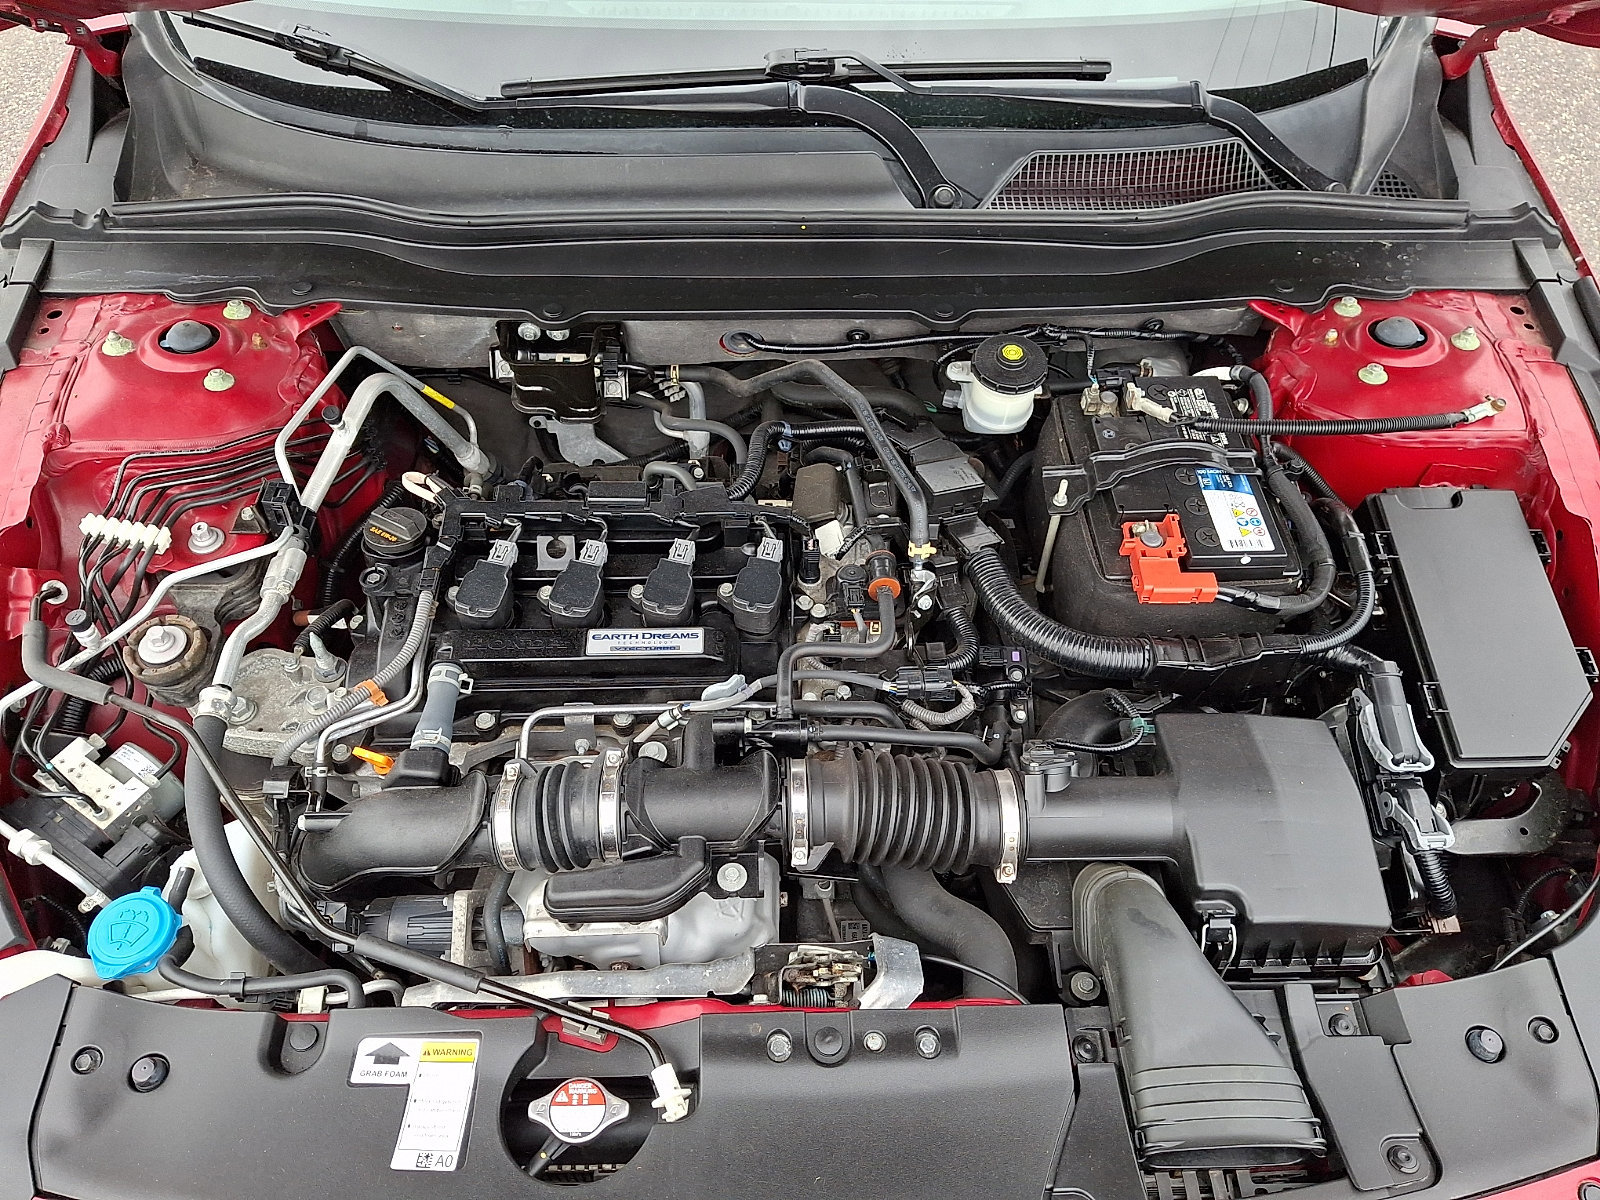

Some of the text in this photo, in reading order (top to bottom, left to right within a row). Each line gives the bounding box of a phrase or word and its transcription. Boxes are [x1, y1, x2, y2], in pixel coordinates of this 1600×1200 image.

[592, 632, 700, 641] EARTH DREAMS
[432, 1048, 473, 1056] WARNING
[359, 1069, 408, 1078] GRAB FOAM
